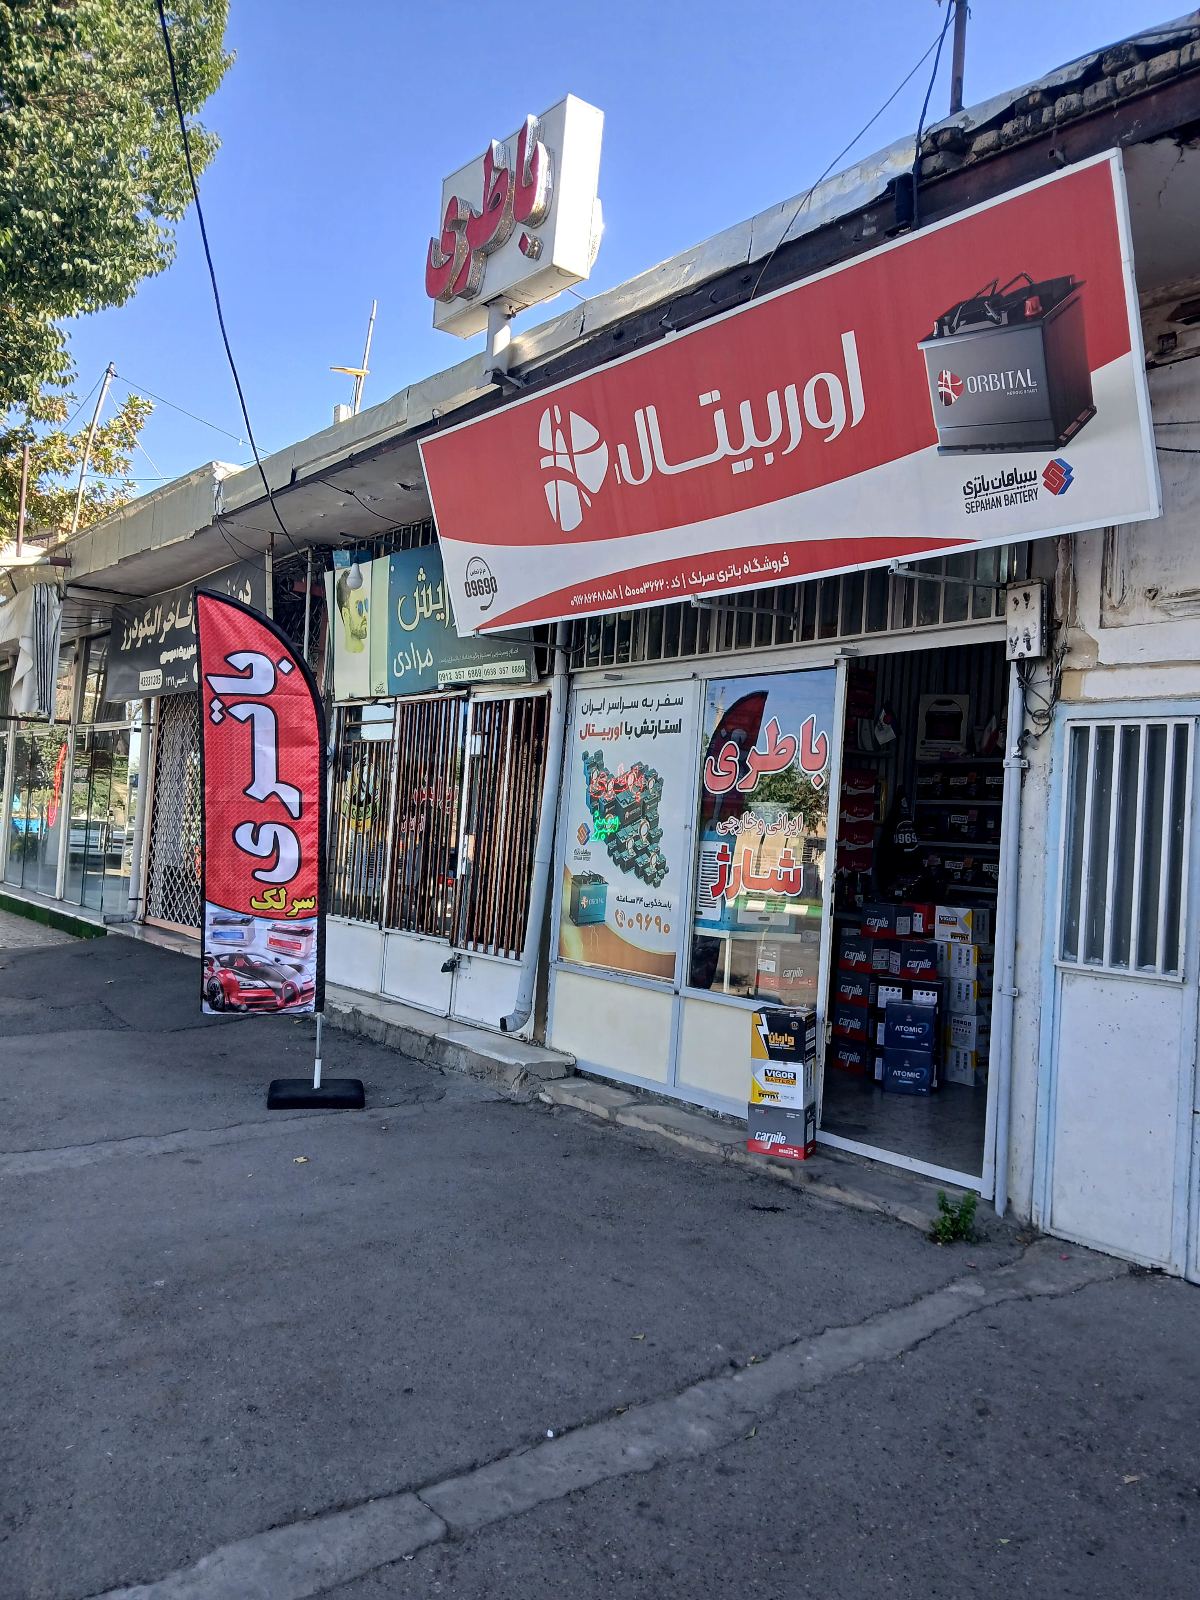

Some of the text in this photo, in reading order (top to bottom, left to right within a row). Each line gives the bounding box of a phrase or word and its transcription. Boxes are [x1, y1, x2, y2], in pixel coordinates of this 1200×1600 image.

[425, 112, 551, 303] باطری
[967, 368, 1037, 393] ORBITAL
[614, 330, 866, 485] اوربیتال
[962, 475, 990, 499] باتری
[965, 488, 1039, 514] SEPAHAN BATTERY
[743, 551, 790, 573] فروشگاه
[688, 570, 715, 587] سرلک
[716, 564, 742, 583] باتری
[464, 576, 498, 598] 09690
[393, 642, 434, 677] مرادی
[581, 693, 684, 716] سفر به سراسر ایران
[579, 721, 623, 741] اوربیتال
[624, 721, 633, 740] با
[704, 714, 829, 794] باطری
[205, 651, 304, 883] باتری
[716, 810, 804, 837] ایرانی و خارجی
[709, 843, 804, 901] شارژ
[627, 912, 671, 934] ۰۹۶۹۰
[866, 916, 889, 932] carpile
[844, 949, 867, 966] carpile
[906, 958, 932, 974] carpile
[783, 966, 804, 984] carpile
[840, 983, 863, 1000] carpile
[838, 1017, 862, 1034] carpile
[894, 1025, 923, 1034] ATOMIC
[765, 1069, 795, 1079] VIGOR
[892, 1069, 921, 1079] ATOMIC
[754, 1131, 787, 1150] carpile
